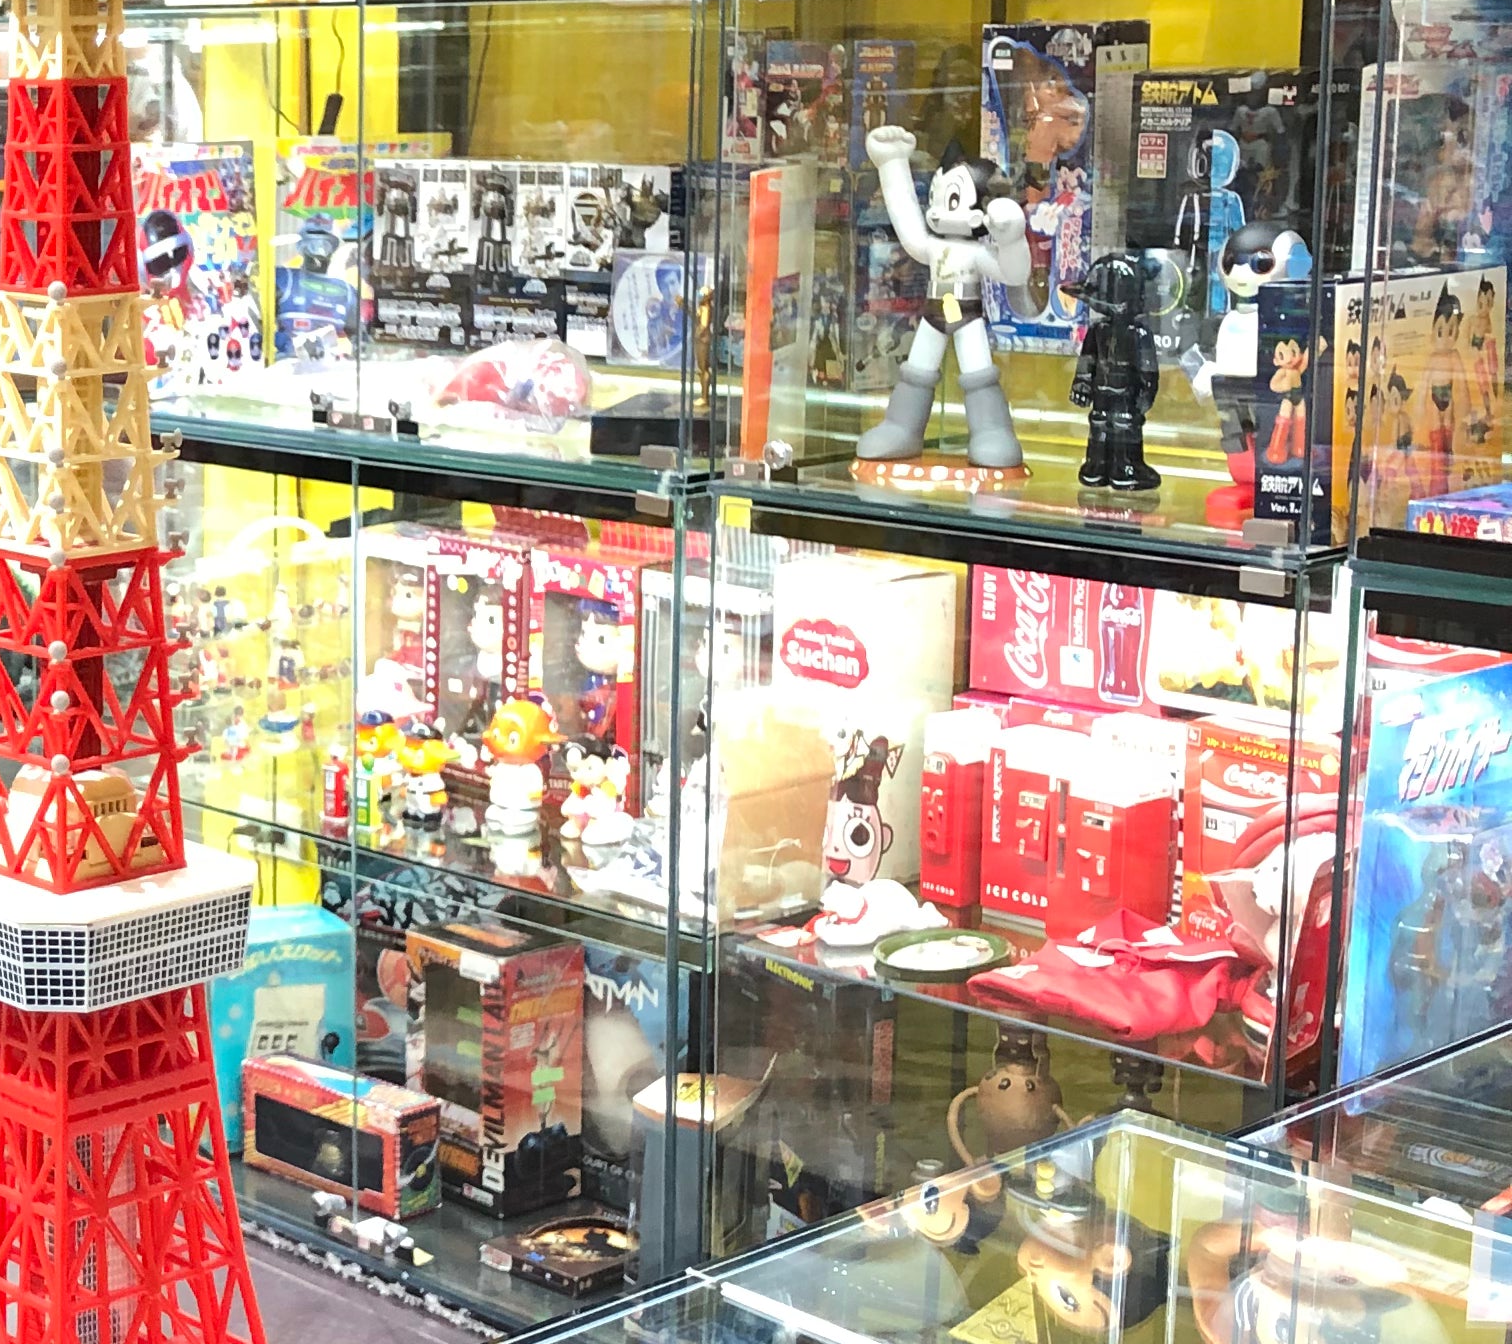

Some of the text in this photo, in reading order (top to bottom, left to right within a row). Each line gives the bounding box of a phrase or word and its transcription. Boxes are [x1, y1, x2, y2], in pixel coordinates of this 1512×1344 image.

[981, 571, 998, 621] ENJOY
[785, 639, 860, 678] Suchan
[986, 883, 1048, 908] ICE COLD
[587, 971, 659, 1013] ATMAN
[765, 957, 816, 993] ELECTRONIC
[481, 1040, 506, 1194] DEVILMAN
